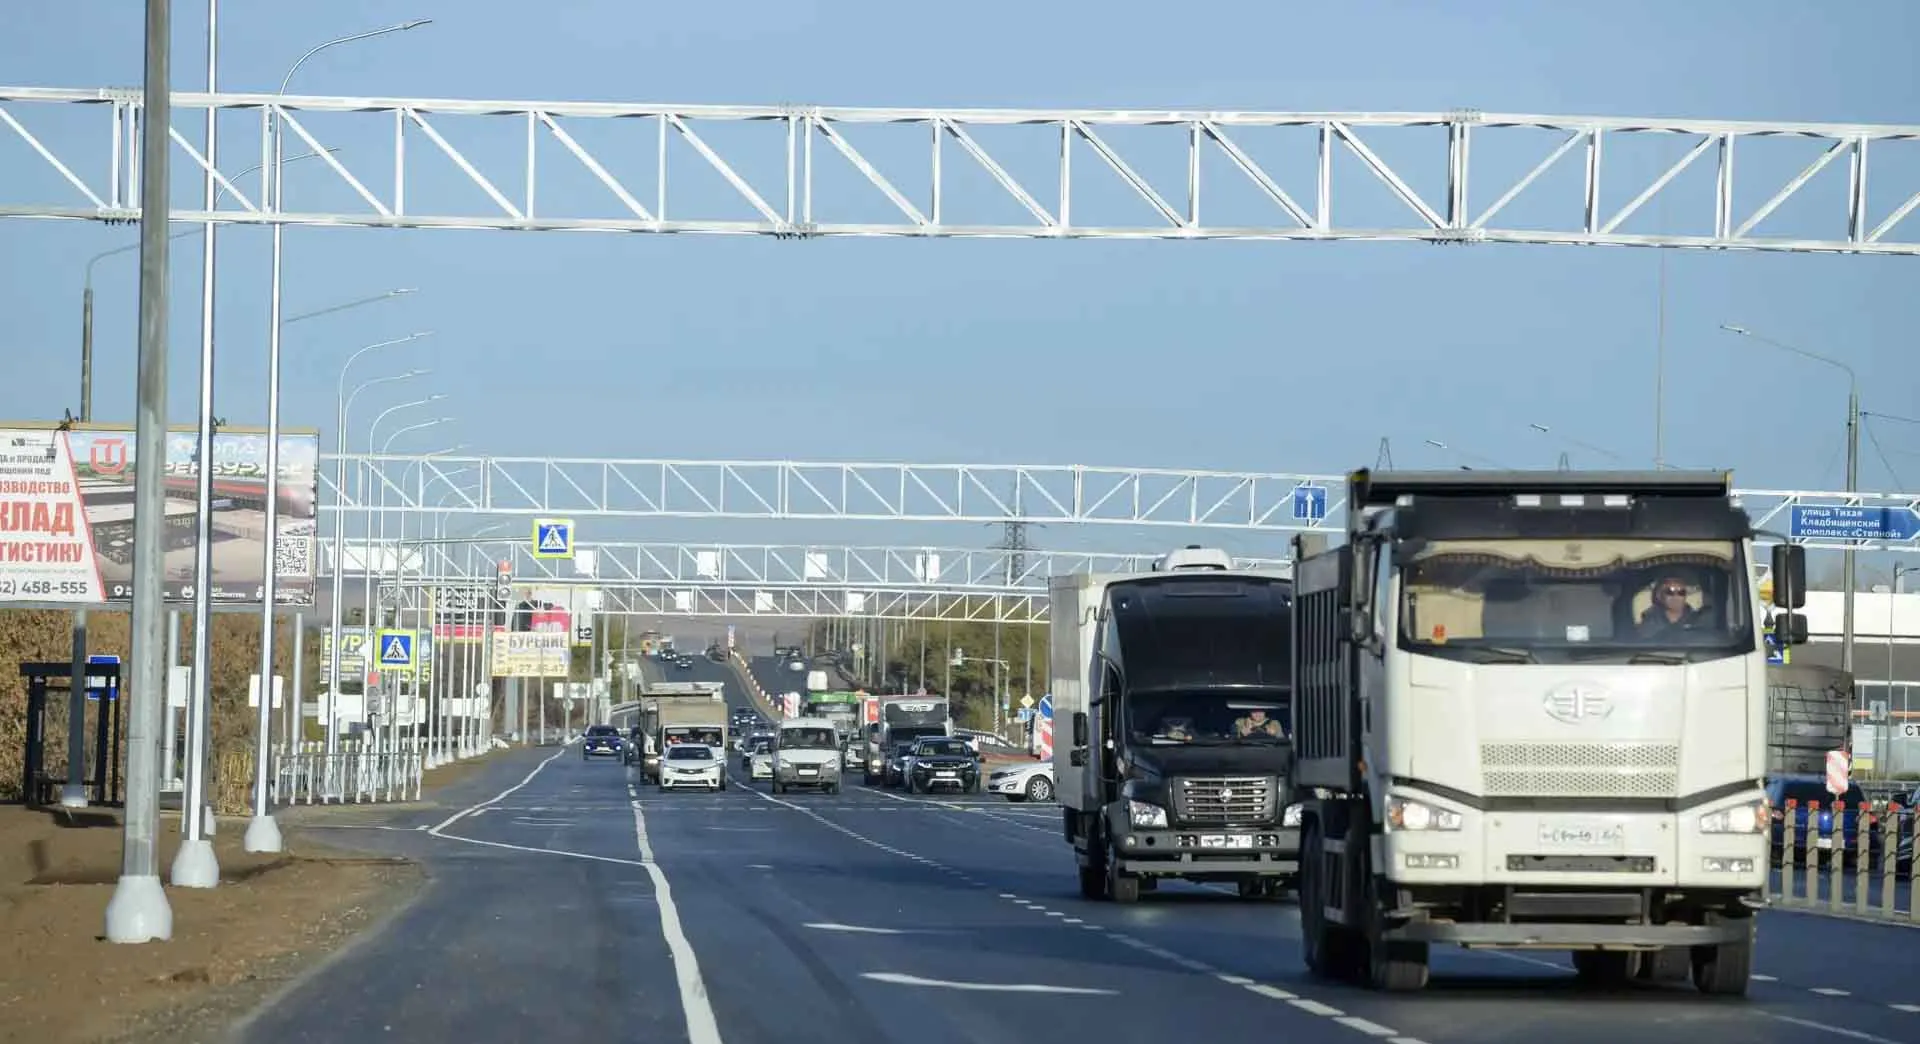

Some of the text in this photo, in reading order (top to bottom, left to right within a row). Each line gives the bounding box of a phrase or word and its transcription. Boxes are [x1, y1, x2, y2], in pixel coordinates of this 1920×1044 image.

[0, 481, 69, 494] ЗВОДСТВО
[1801, 508, 1863, 518] улица Тихая
[1800, 528, 1848, 537] комплекс
[22, 581, 88, 594] 458-555
